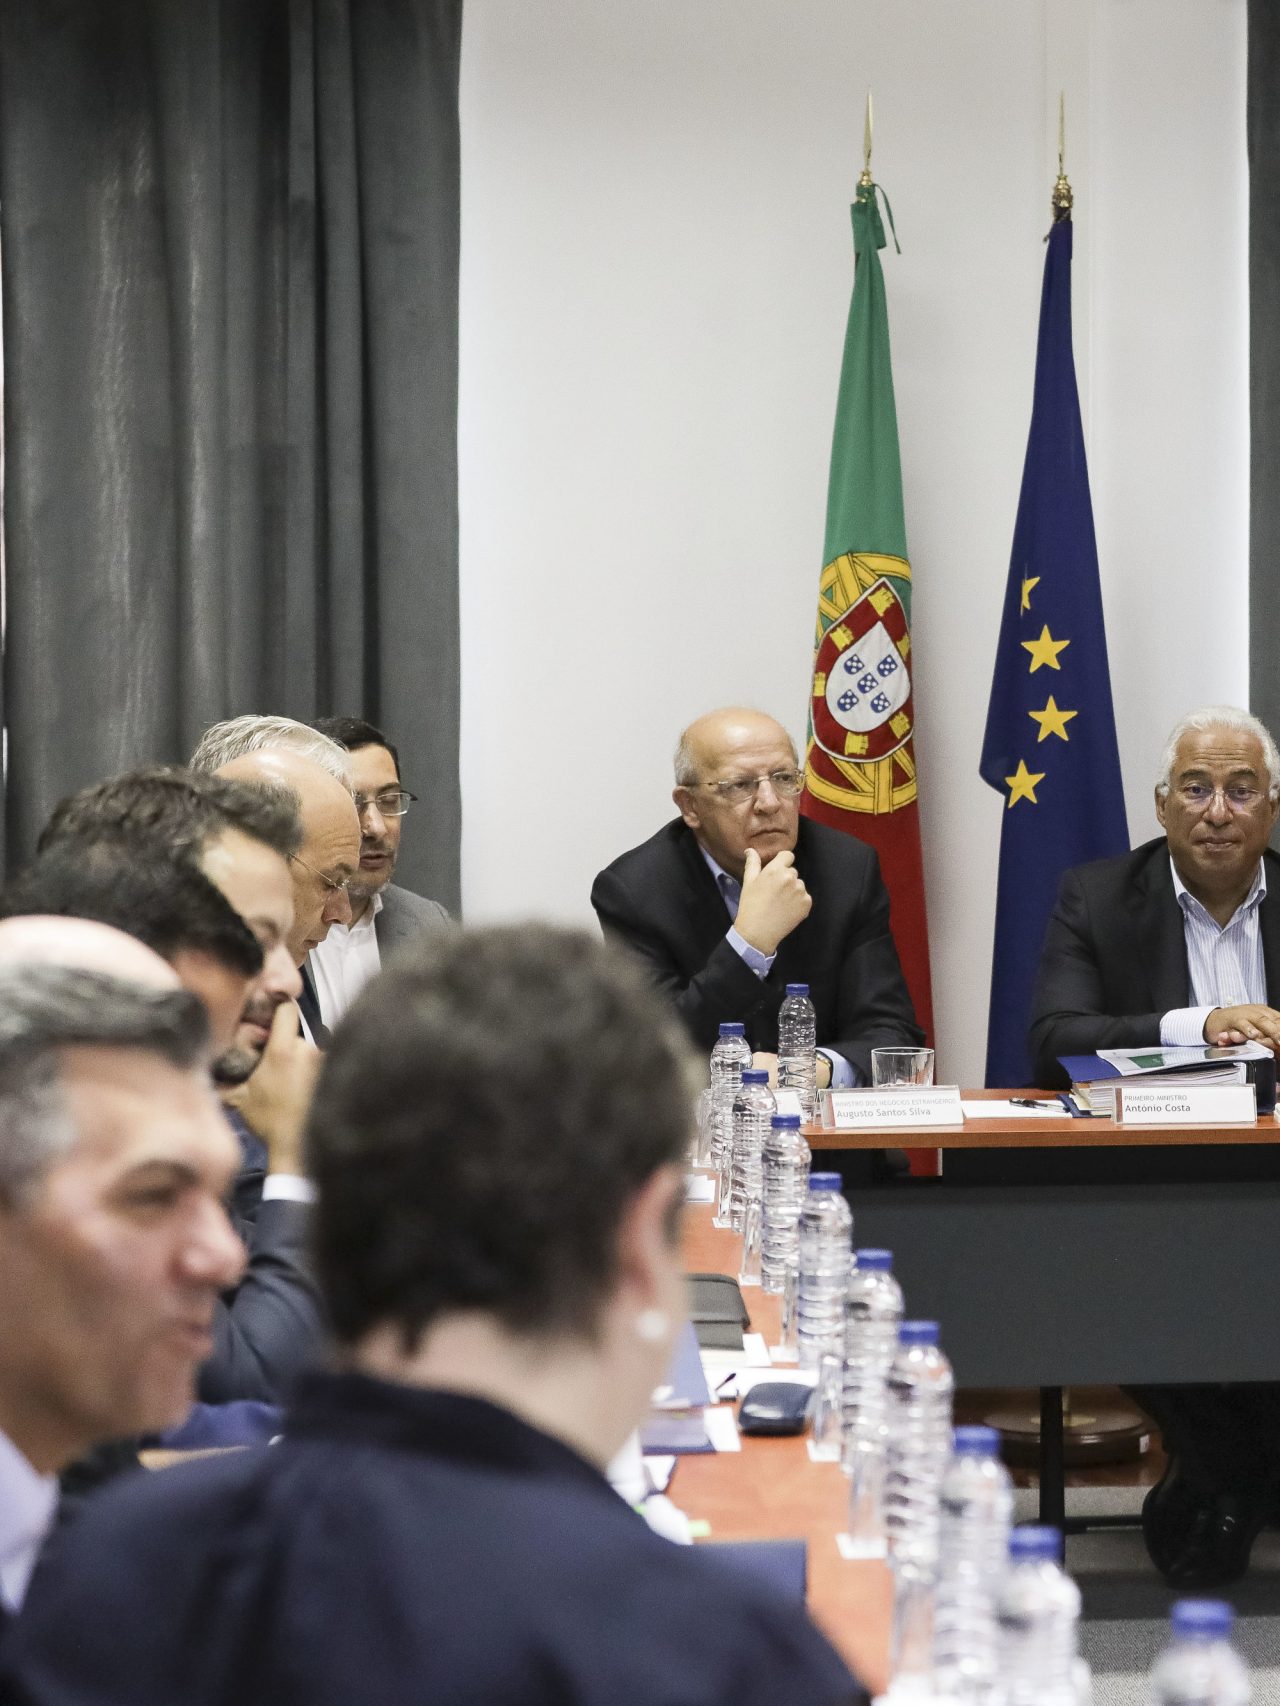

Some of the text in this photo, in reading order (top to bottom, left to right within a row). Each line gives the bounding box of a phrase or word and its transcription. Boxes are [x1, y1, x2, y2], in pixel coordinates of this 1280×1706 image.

[1125, 1103, 1191, 1112] António Costa
[836, 1107, 931, 1120] Augusto Santos Silva
